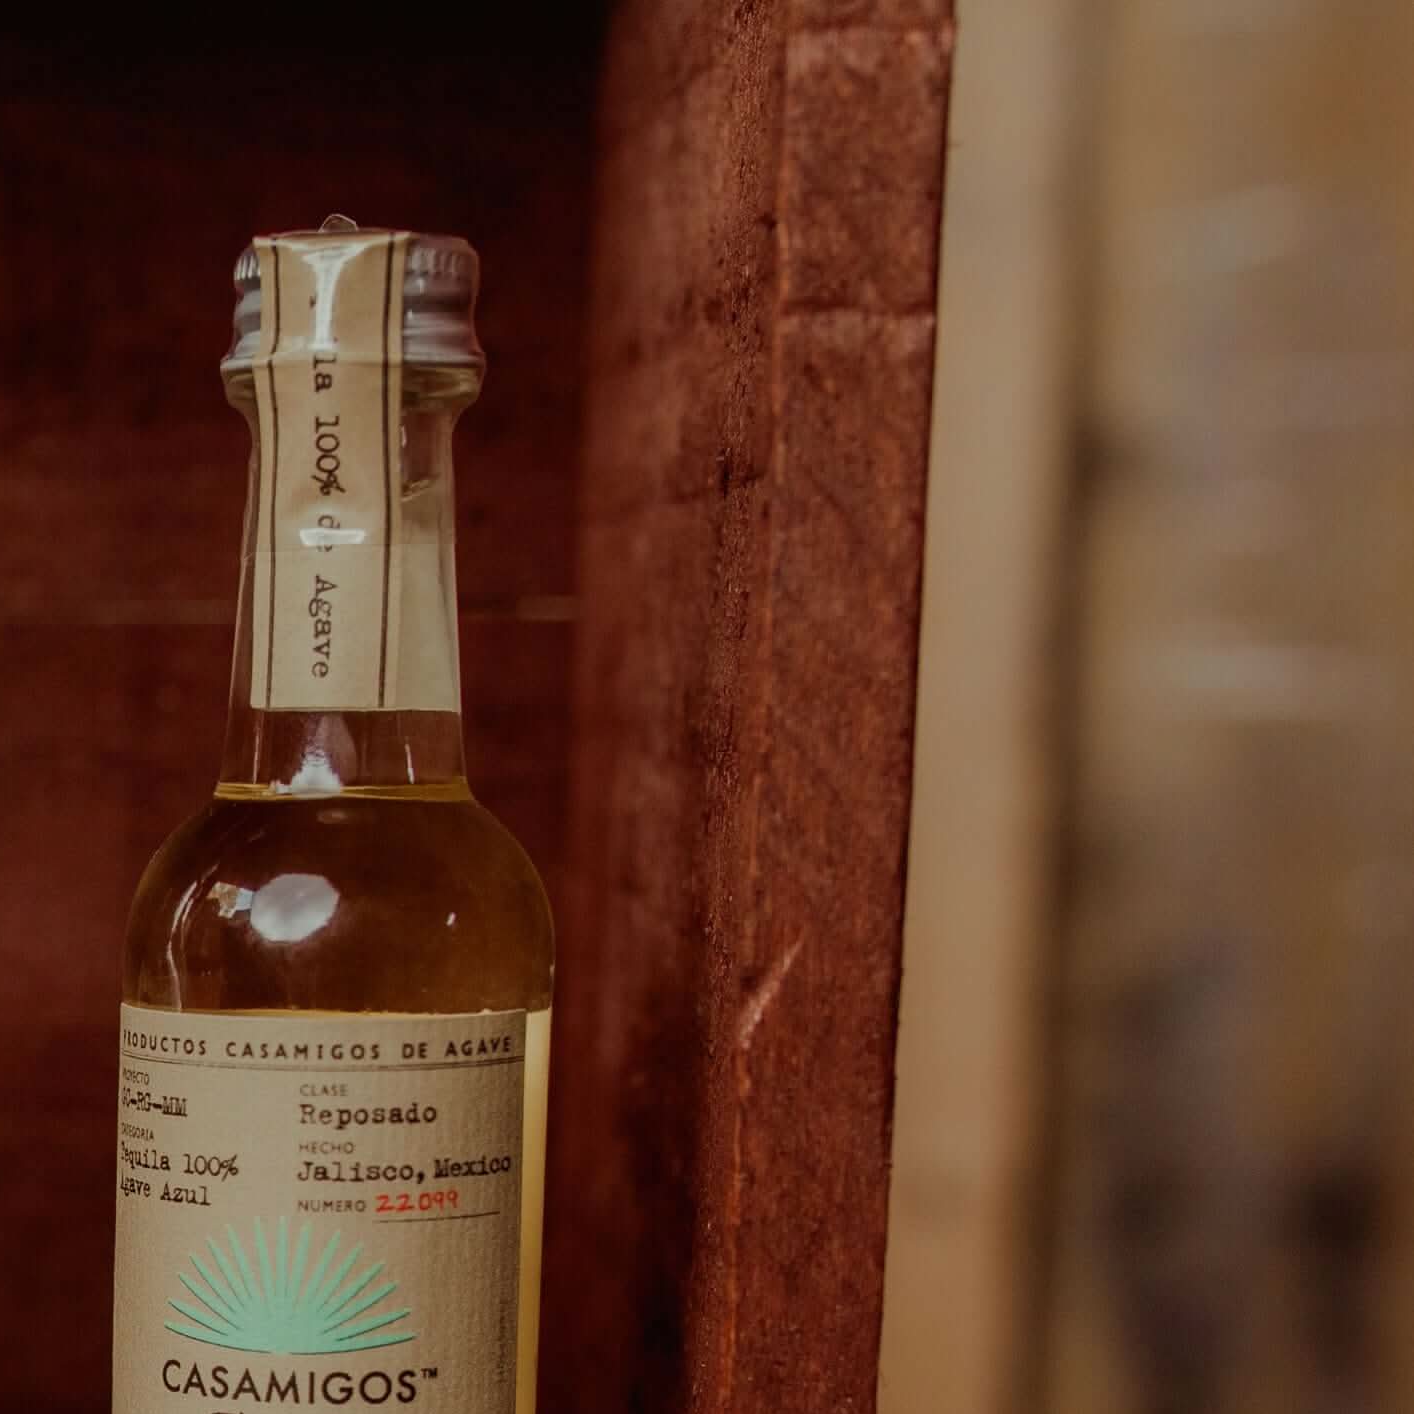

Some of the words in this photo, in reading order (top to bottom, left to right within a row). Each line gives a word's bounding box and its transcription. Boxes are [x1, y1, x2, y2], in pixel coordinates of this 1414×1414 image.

[312, 416, 346, 496] 100%
[309, 576, 338, 678] Agave
[122, 1029, 207, 1056] PRODUCTOS
[225, 1042, 381, 1061] CASAMIGOS
[402, 1042, 428, 1059] DE
[445, 1037, 513, 1058] AGAVE
[299, 1083, 350, 1098] CLASE
[299, 1103, 438, 1130] Reposado
[120, 1142, 172, 1172] Tequila
[184, 1154, 239, 1180] 100%
[298, 1143, 355, 1155] HECHO
[297, 1160, 425, 1184] Jalisco,
[434, 1153, 511, 1179] Mexico
[119, 1172, 151, 1199] Agave
[160, 1184, 212, 1206] Azul
[298, 1198, 366, 1213] NUMERO
